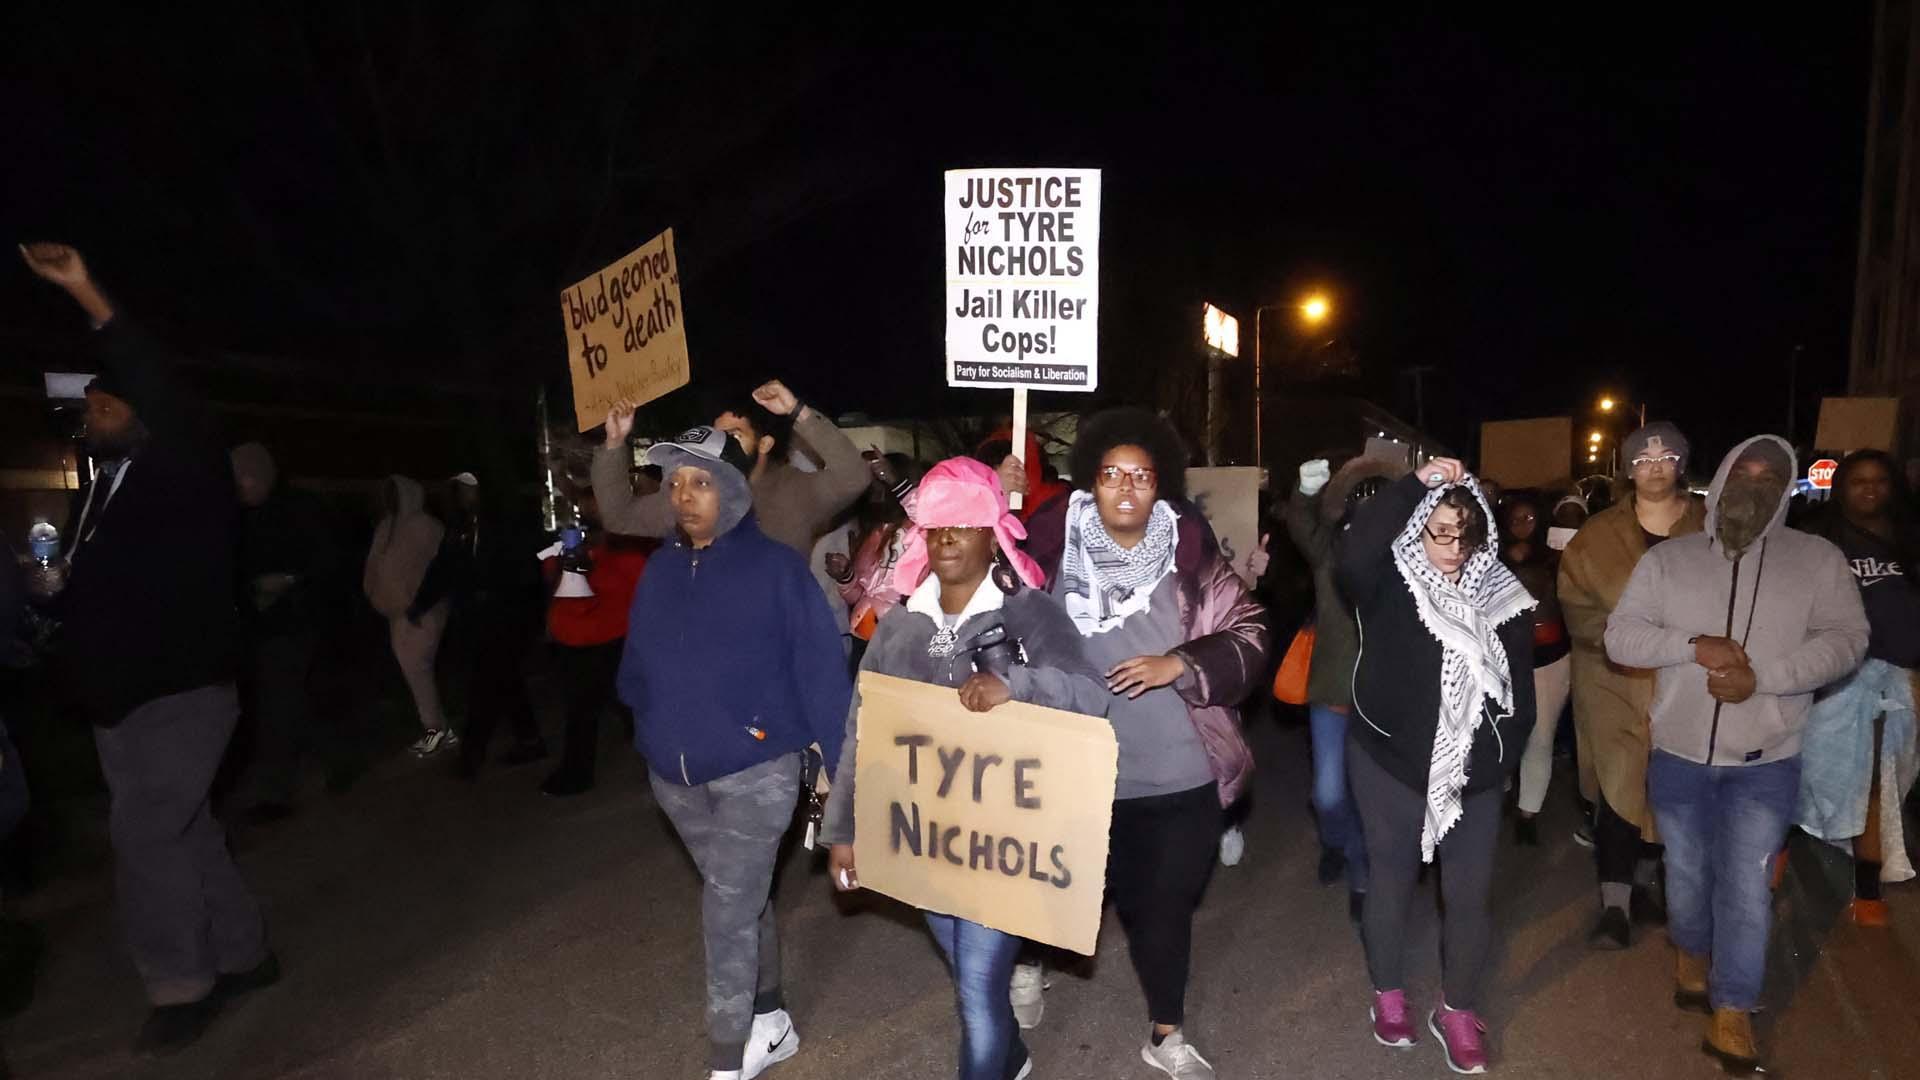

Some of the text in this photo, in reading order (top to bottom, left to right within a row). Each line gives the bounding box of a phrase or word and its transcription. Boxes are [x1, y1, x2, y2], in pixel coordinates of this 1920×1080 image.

[959, 176, 1081, 208] JUSTICE
[964, 211, 1075, 244] for TYRE
[958, 246, 1084, 276] NICHOLS
[955, 289, 1087, 320] Jail Killer
[581, 333, 608, 379] to
[982, 323, 1056, 360] Cops!
[956, 364, 1086, 381] Party for Socialism & Liberation
[889, 801, 1072, 889] NICHOLS
